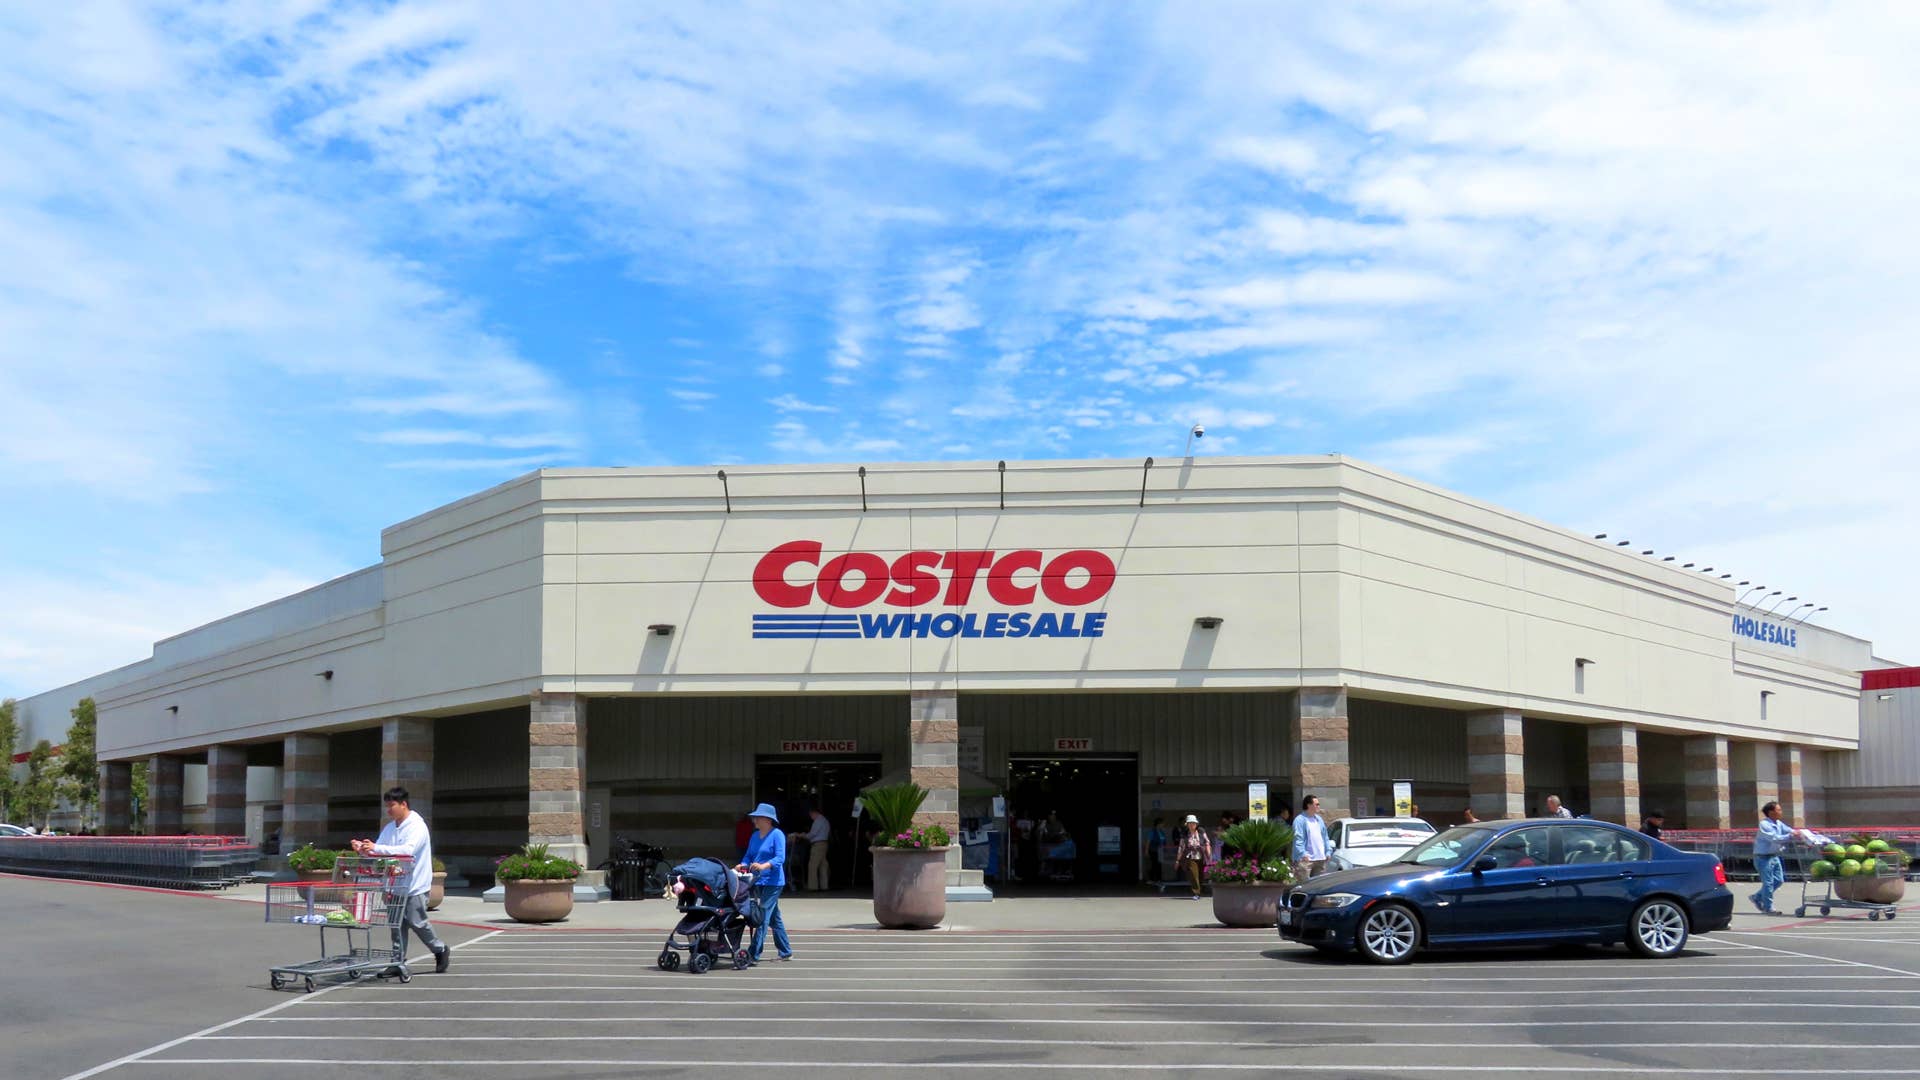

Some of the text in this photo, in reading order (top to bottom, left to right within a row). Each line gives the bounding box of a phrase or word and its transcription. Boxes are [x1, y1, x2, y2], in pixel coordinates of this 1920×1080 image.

[753, 540, 1116, 608] COSTCO
[860, 613, 1107, 638] WHOLESALE
[782, 741, 855, 752] ENTRANCE
[1058, 739, 1089, 750] EXIT
